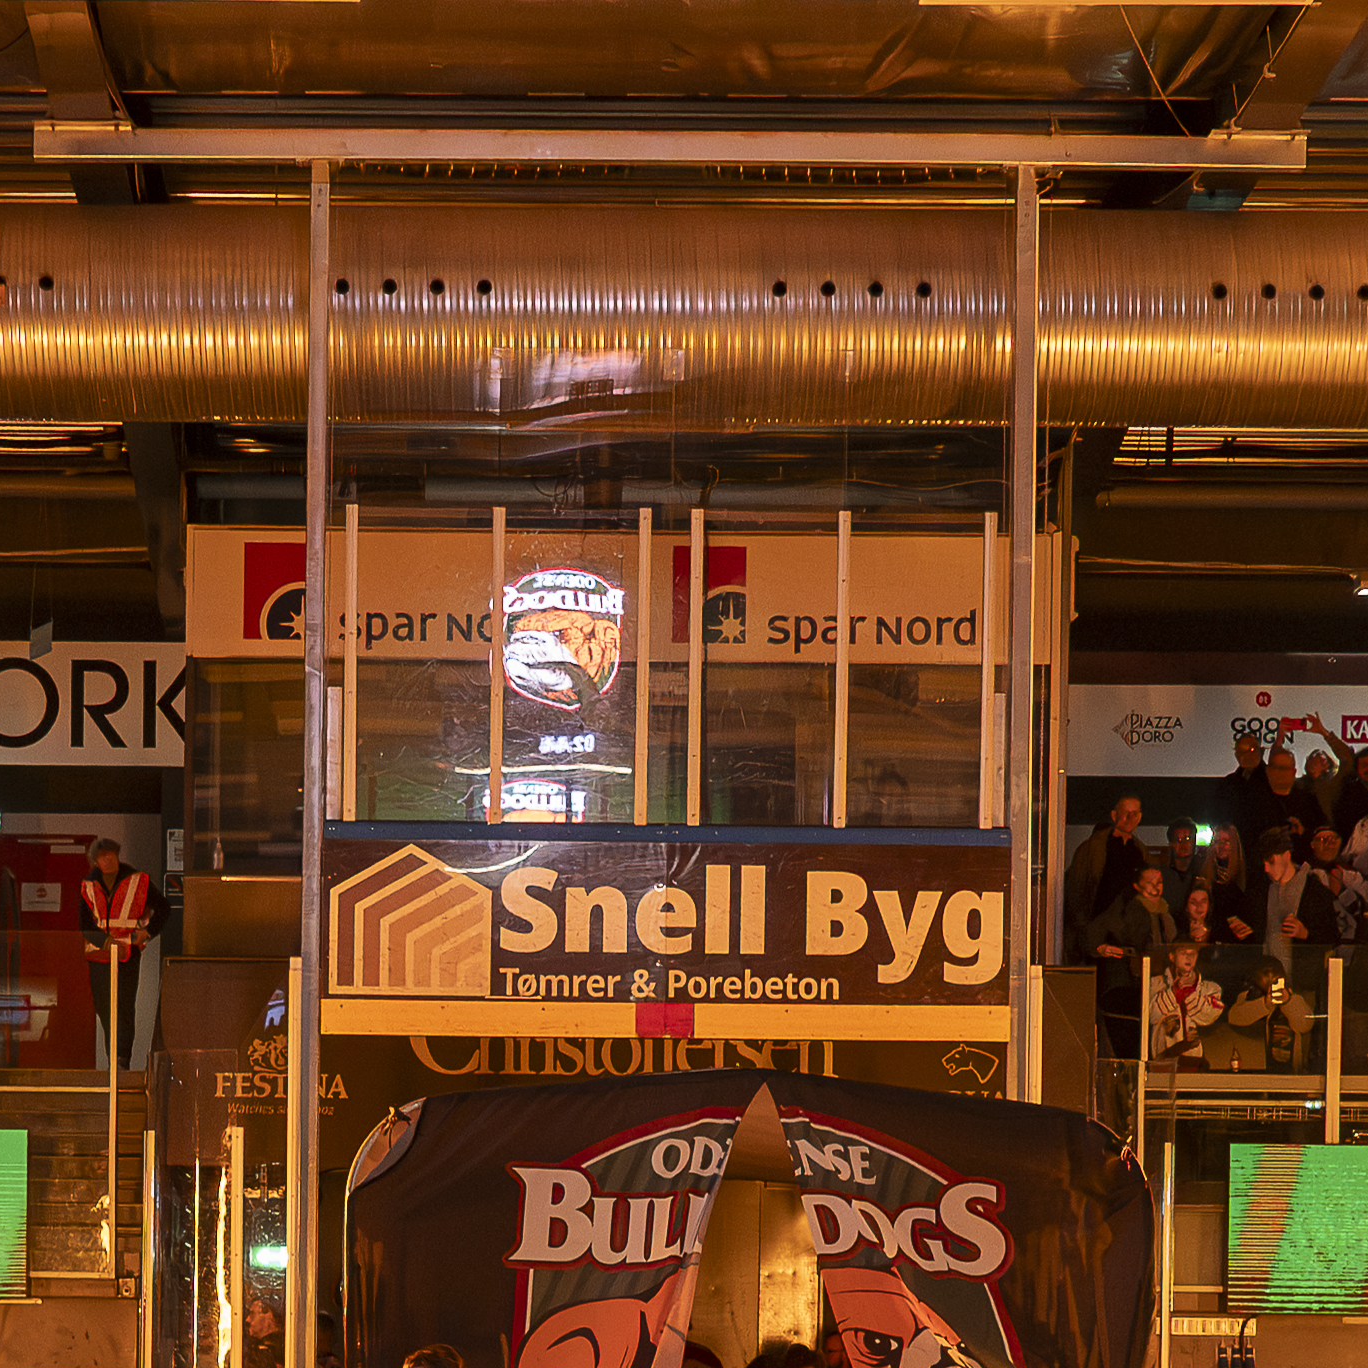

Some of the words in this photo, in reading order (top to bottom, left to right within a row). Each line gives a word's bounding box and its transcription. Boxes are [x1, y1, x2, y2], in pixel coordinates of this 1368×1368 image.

[499, 864, 767, 956] Snell
[805, 870, 1005, 986] Byg
[499, 966, 622, 1000] Tømrer
[630, 969, 658, 1000] &
[667, 968, 841, 1001] Porebeton
